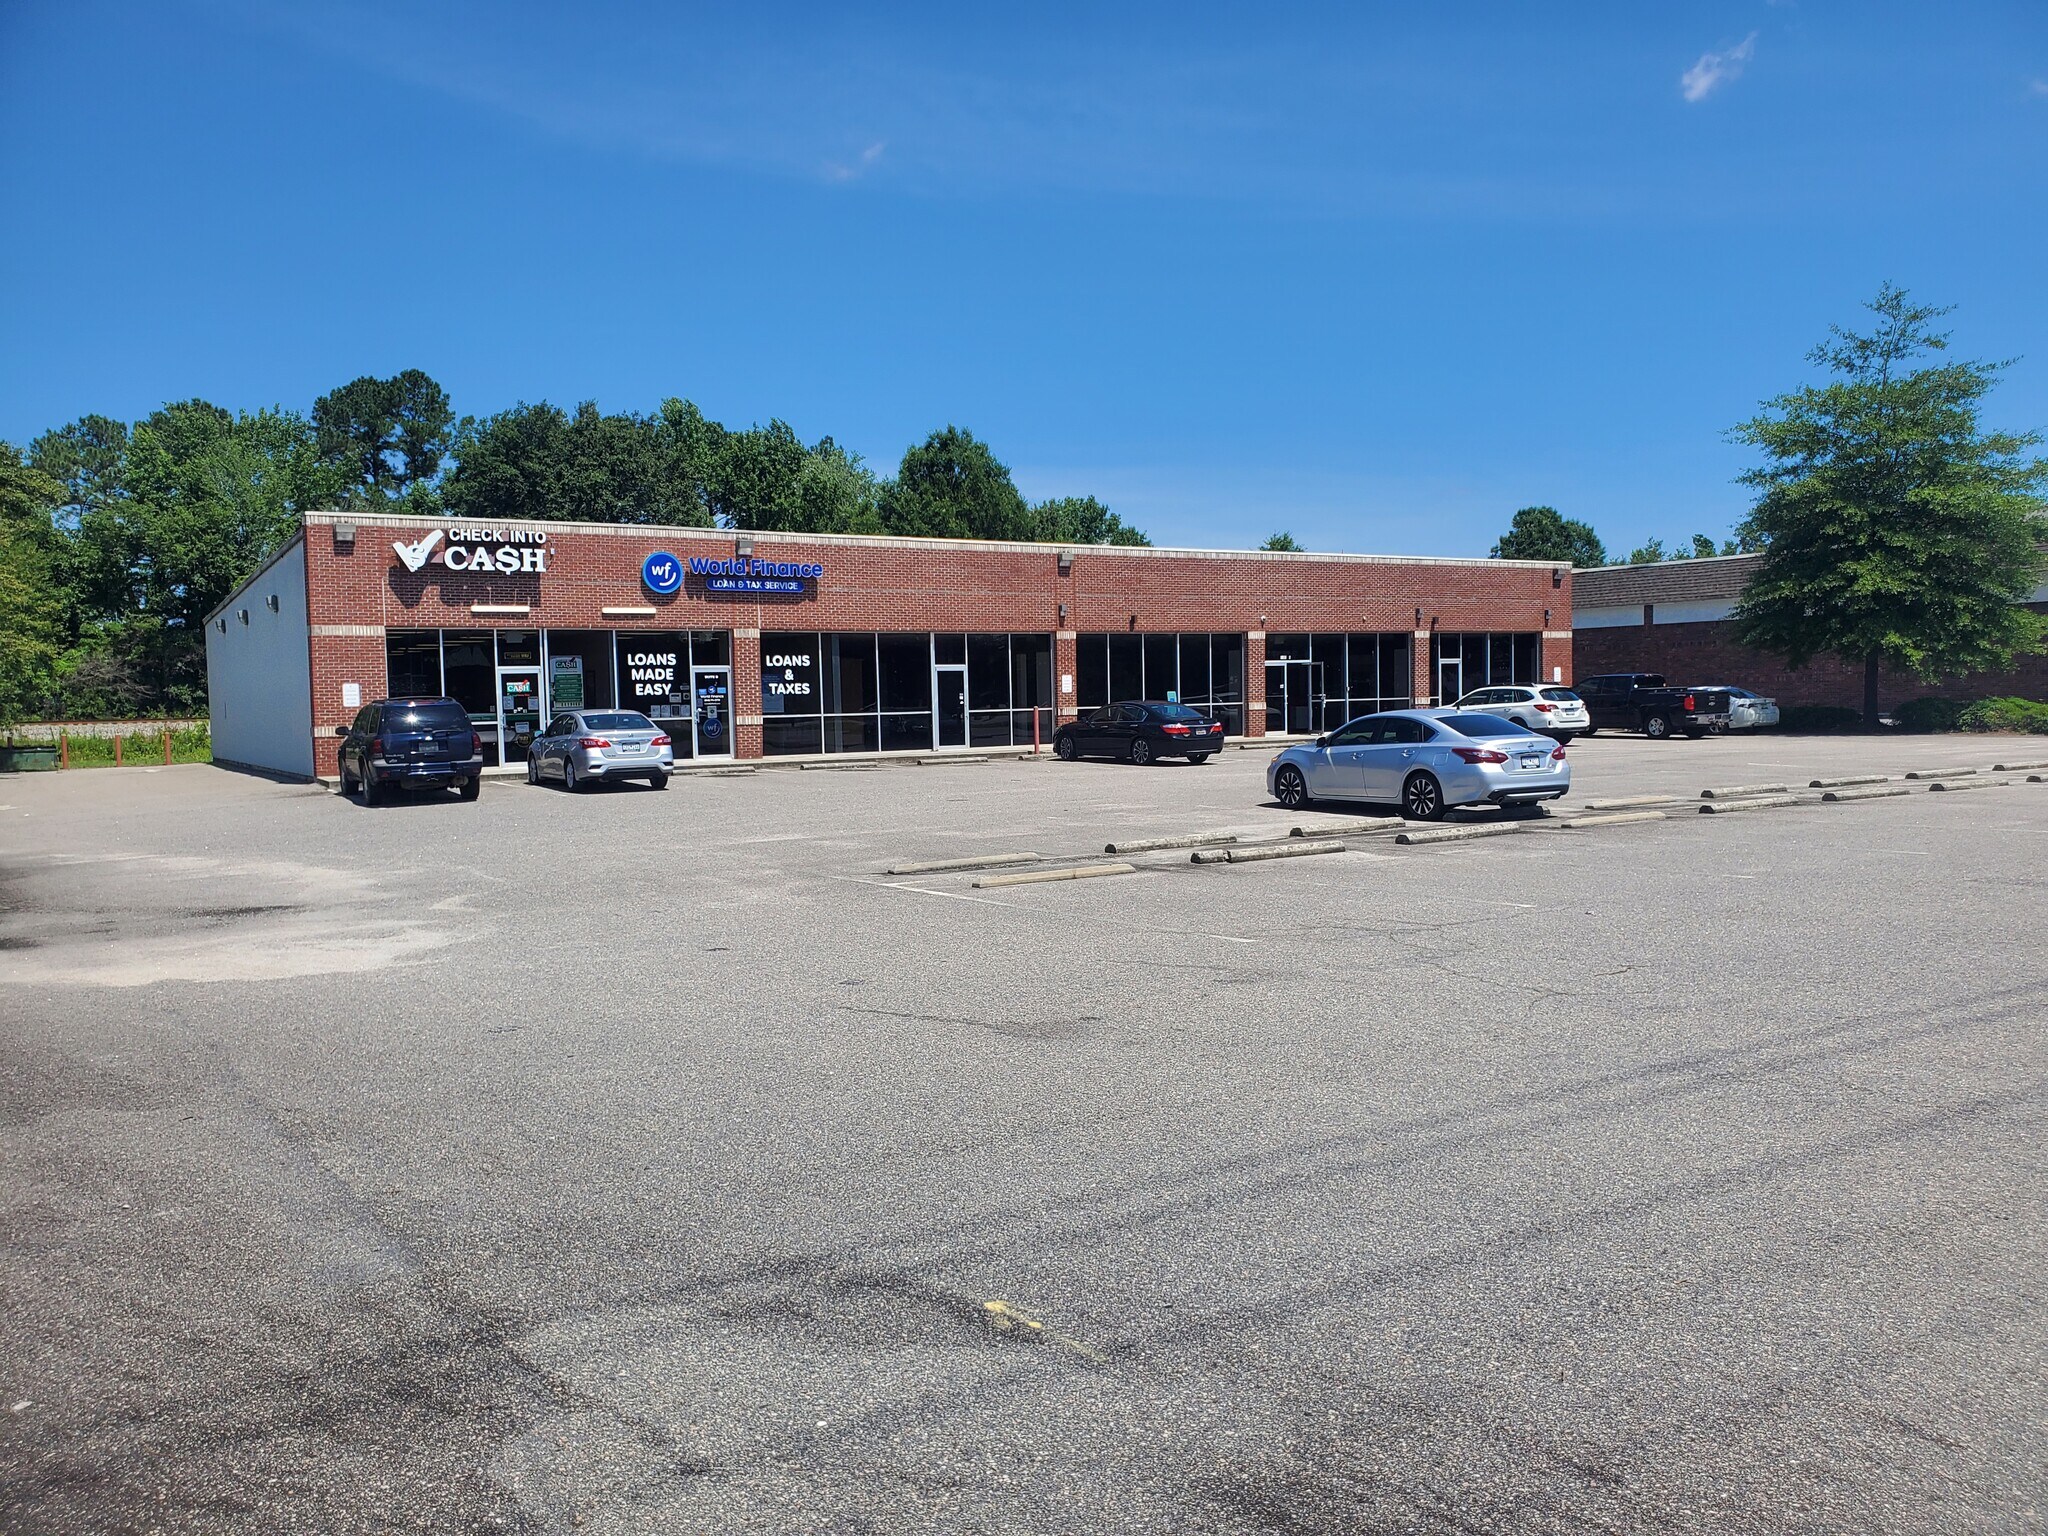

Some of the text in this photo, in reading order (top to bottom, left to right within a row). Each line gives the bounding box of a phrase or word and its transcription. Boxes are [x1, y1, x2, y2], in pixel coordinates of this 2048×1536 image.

[449, 528, 547, 544] CHECK INTO
[651, 562, 672, 580] wf
[688, 557, 823, 578] World Finance
[712, 580, 735, 589] LOAN
[746, 581, 763, 590] TAX
[764, 581, 799, 590] SERVICE
[627, 653, 677, 666] LOANS
[765, 654, 811, 667] LOANS
[631, 668, 674, 680] MADE
[784, 669, 794, 681] &
[635, 683, 672, 696] EASY
[768, 682, 811, 695] TAXES
